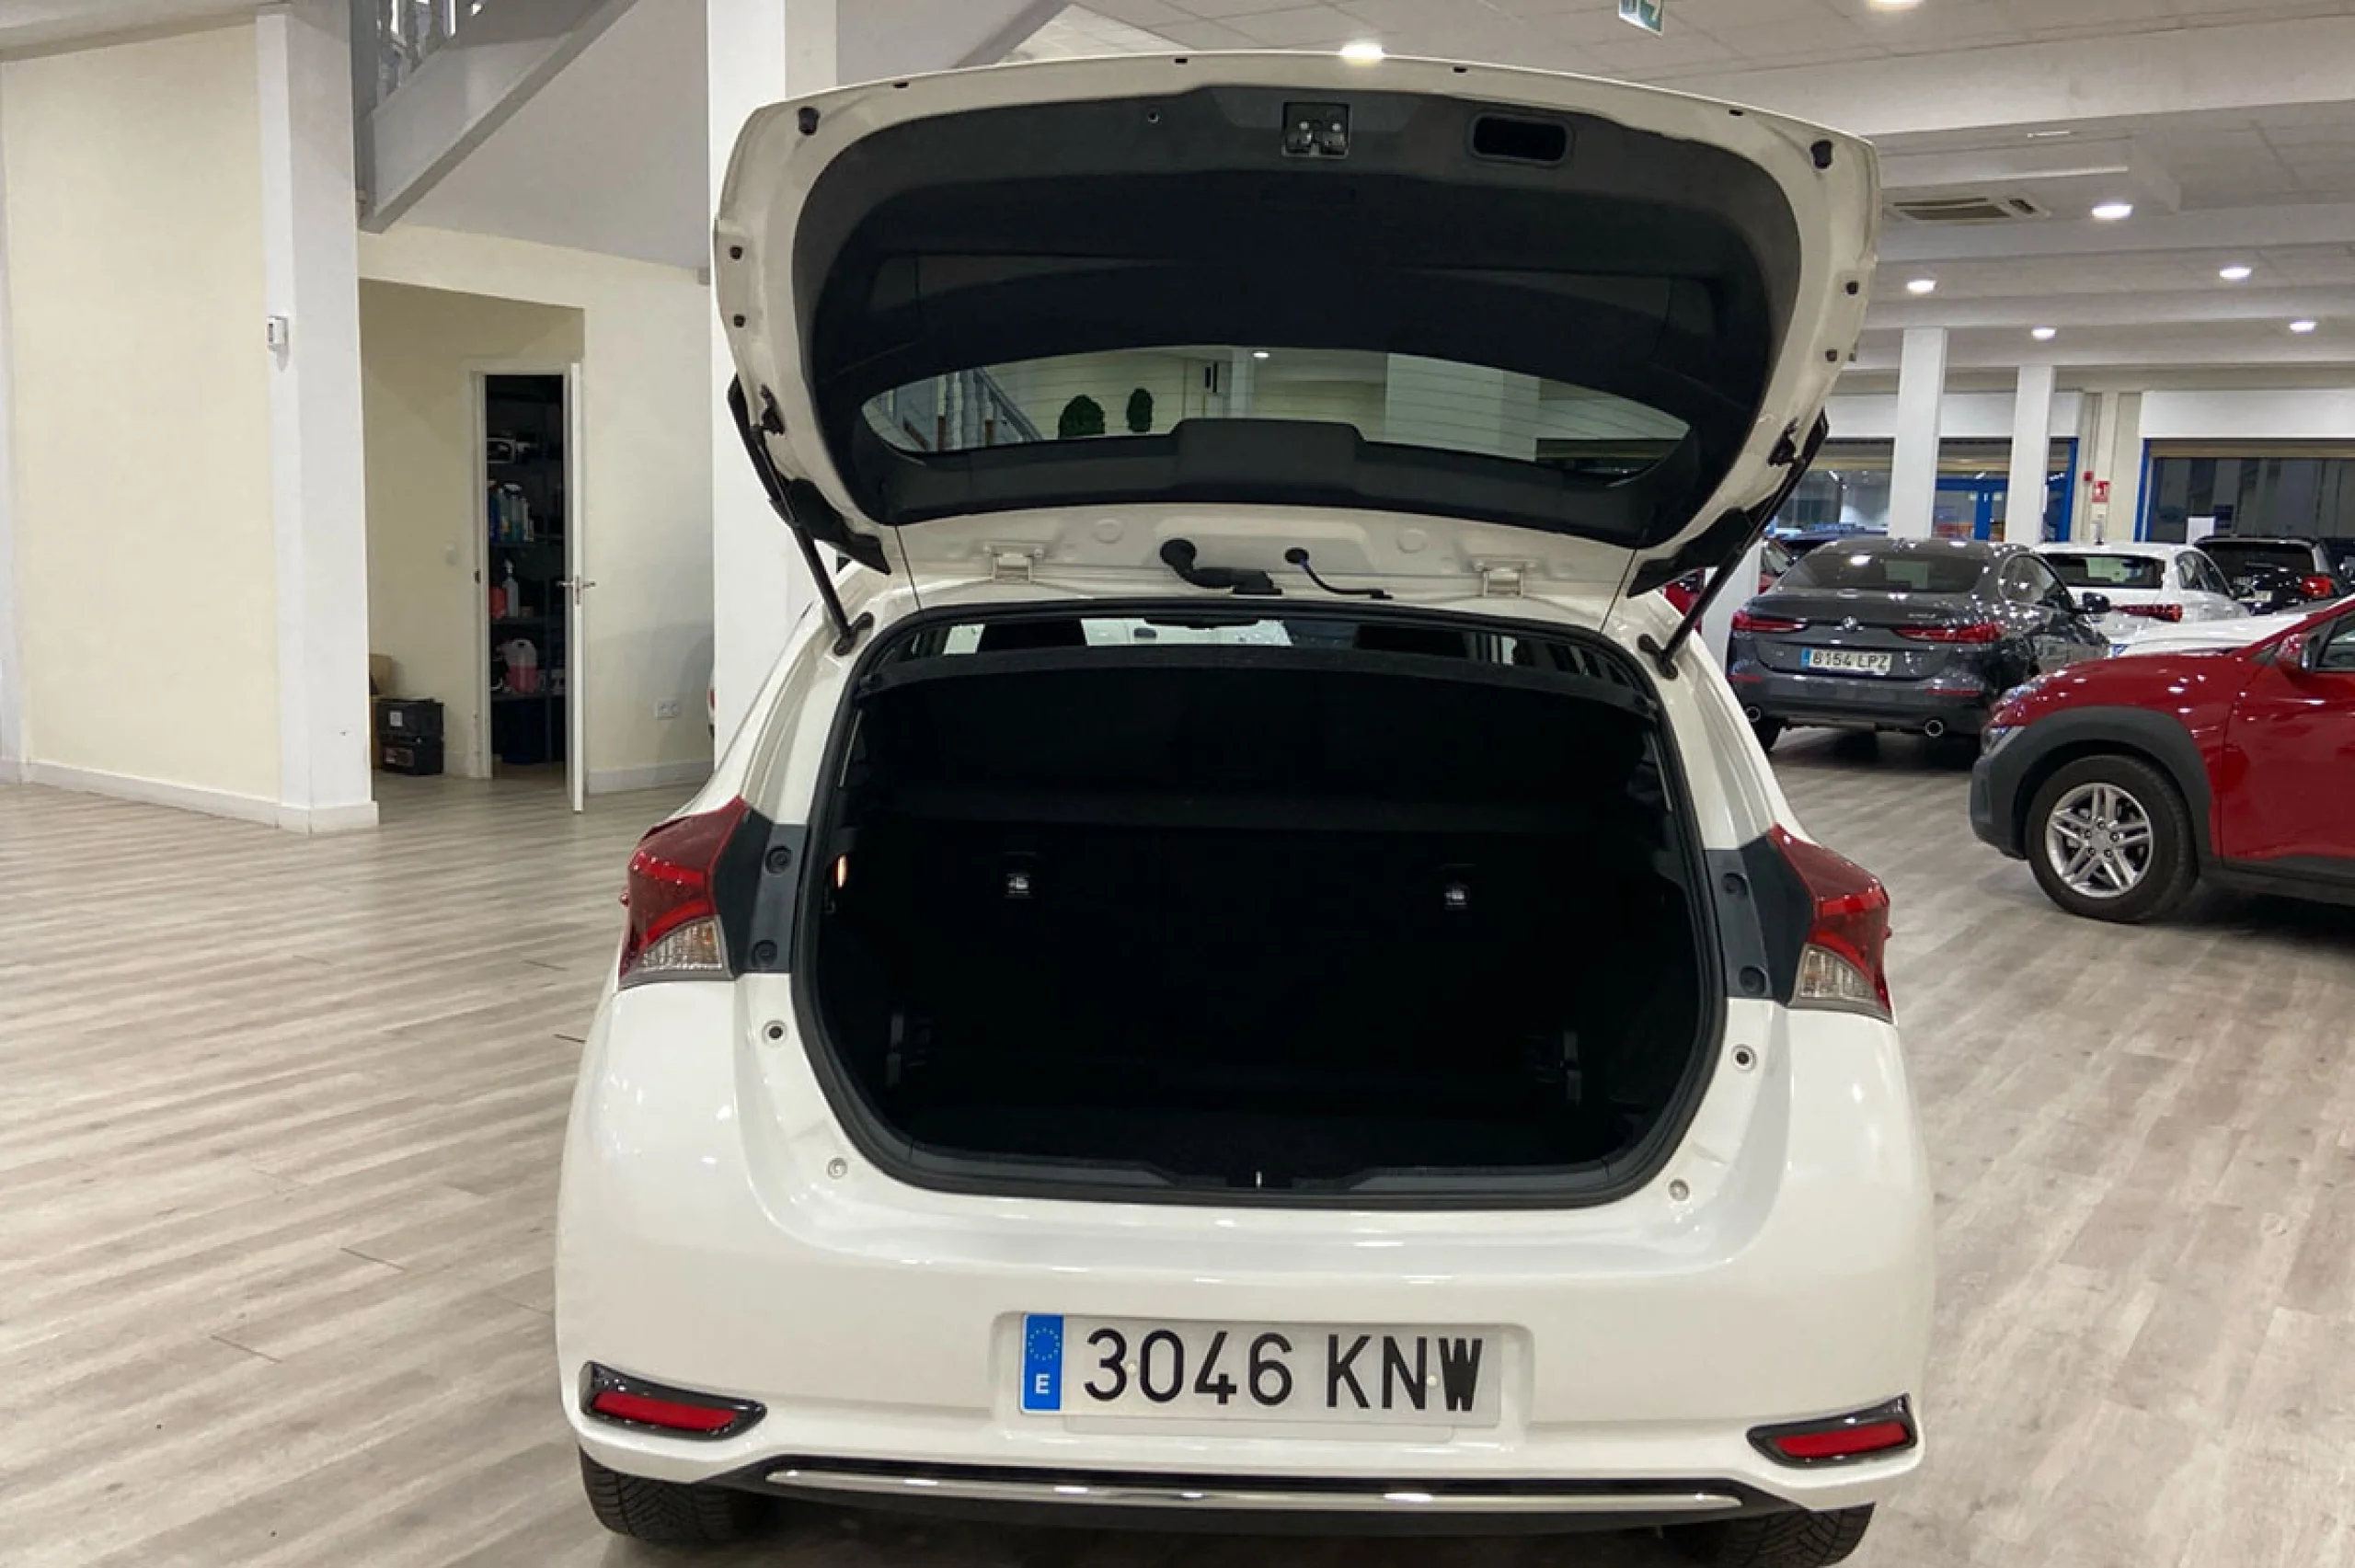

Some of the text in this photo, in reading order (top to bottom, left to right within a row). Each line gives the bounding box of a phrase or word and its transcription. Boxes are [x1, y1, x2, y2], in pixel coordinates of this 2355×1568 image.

[1857, 654, 1889, 670] LPZ
[1084, 1328, 1483, 1412] 3046 KNW
[1035, 1373, 1051, 1394] E
